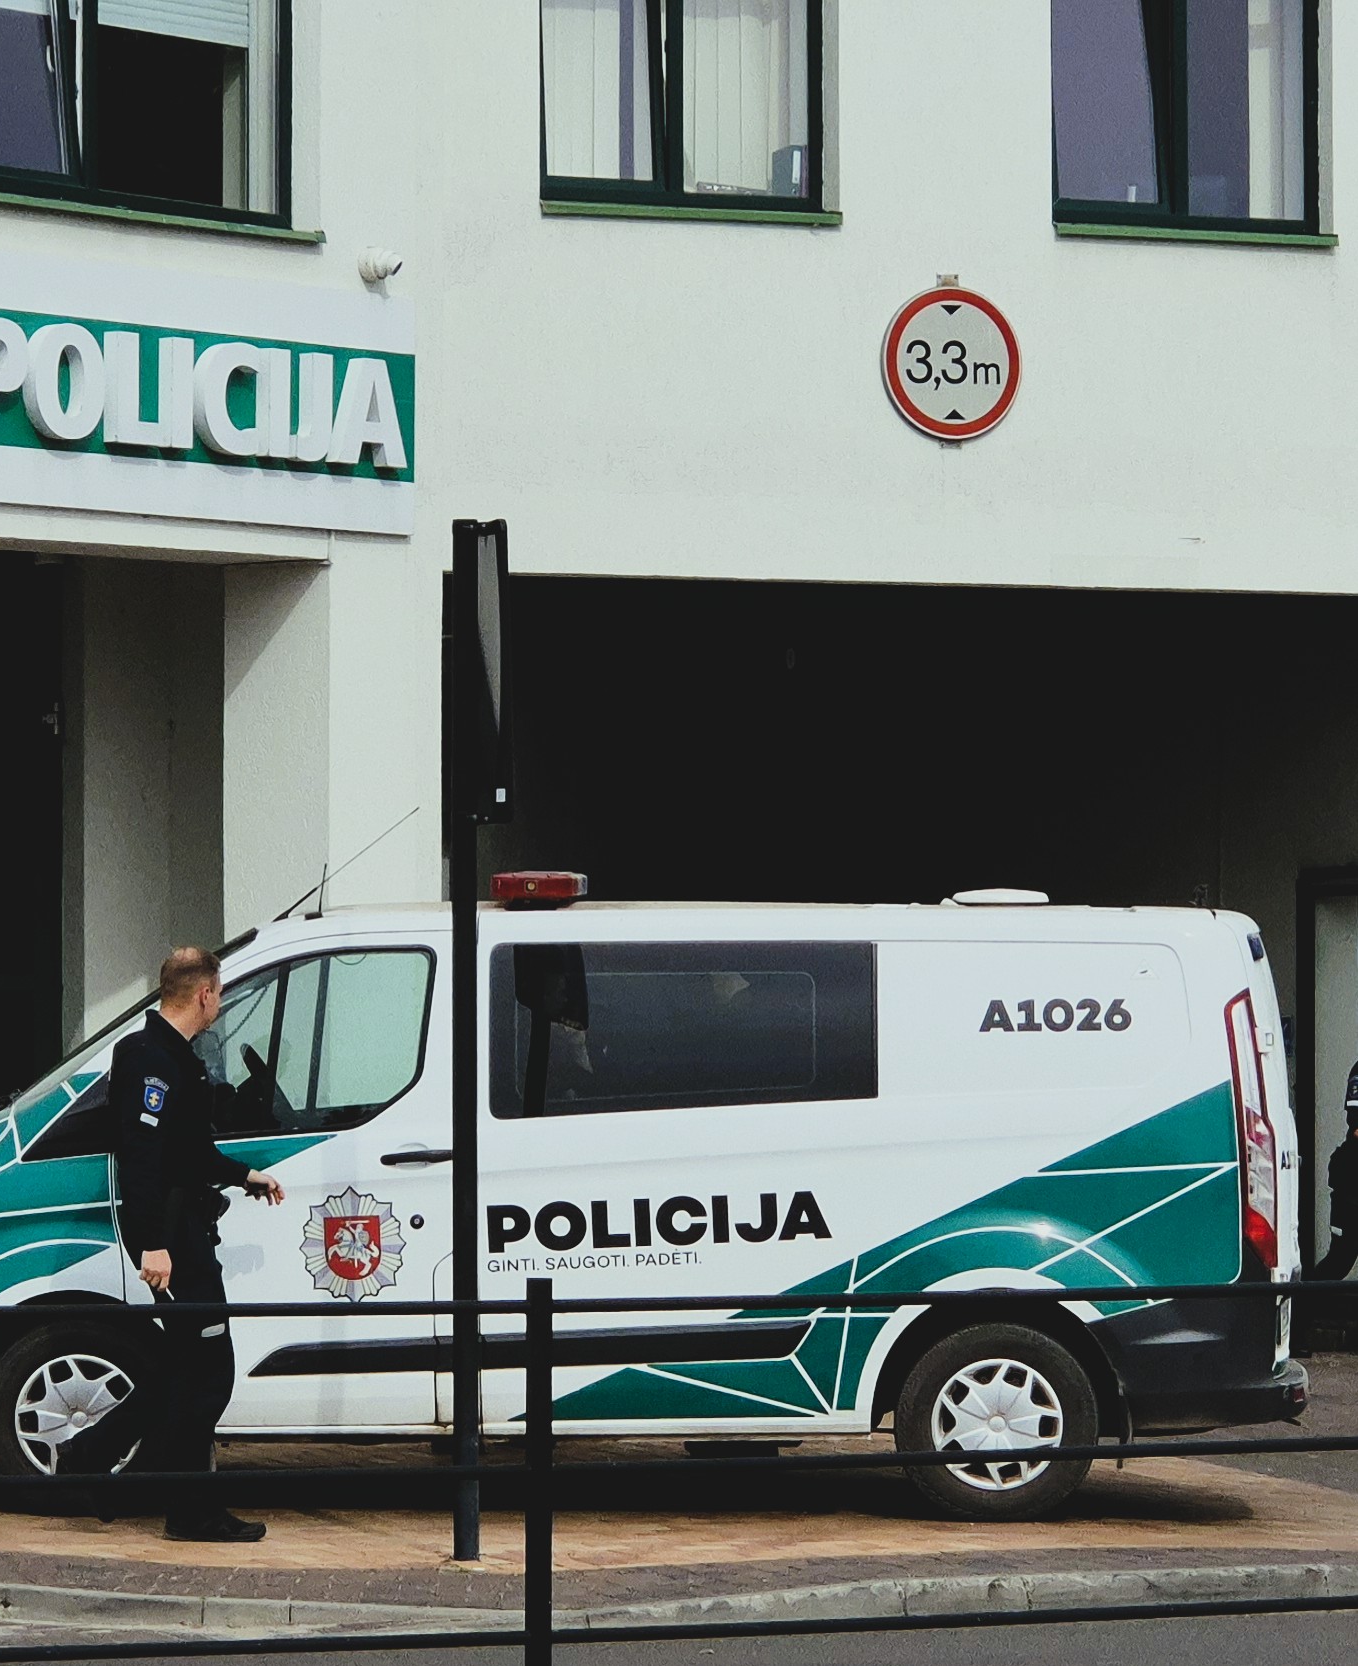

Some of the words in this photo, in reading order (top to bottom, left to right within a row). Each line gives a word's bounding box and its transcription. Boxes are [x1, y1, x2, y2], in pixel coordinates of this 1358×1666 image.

[979, 998, 1132, 1033] A1026
[487, 1190, 833, 1254] POLICIJA
[487, 1258, 540, 1273] GINTI.
[545, 1254, 630, 1271] SAUGOTI.
[635, 1248, 702, 1267] PADĖTI.
